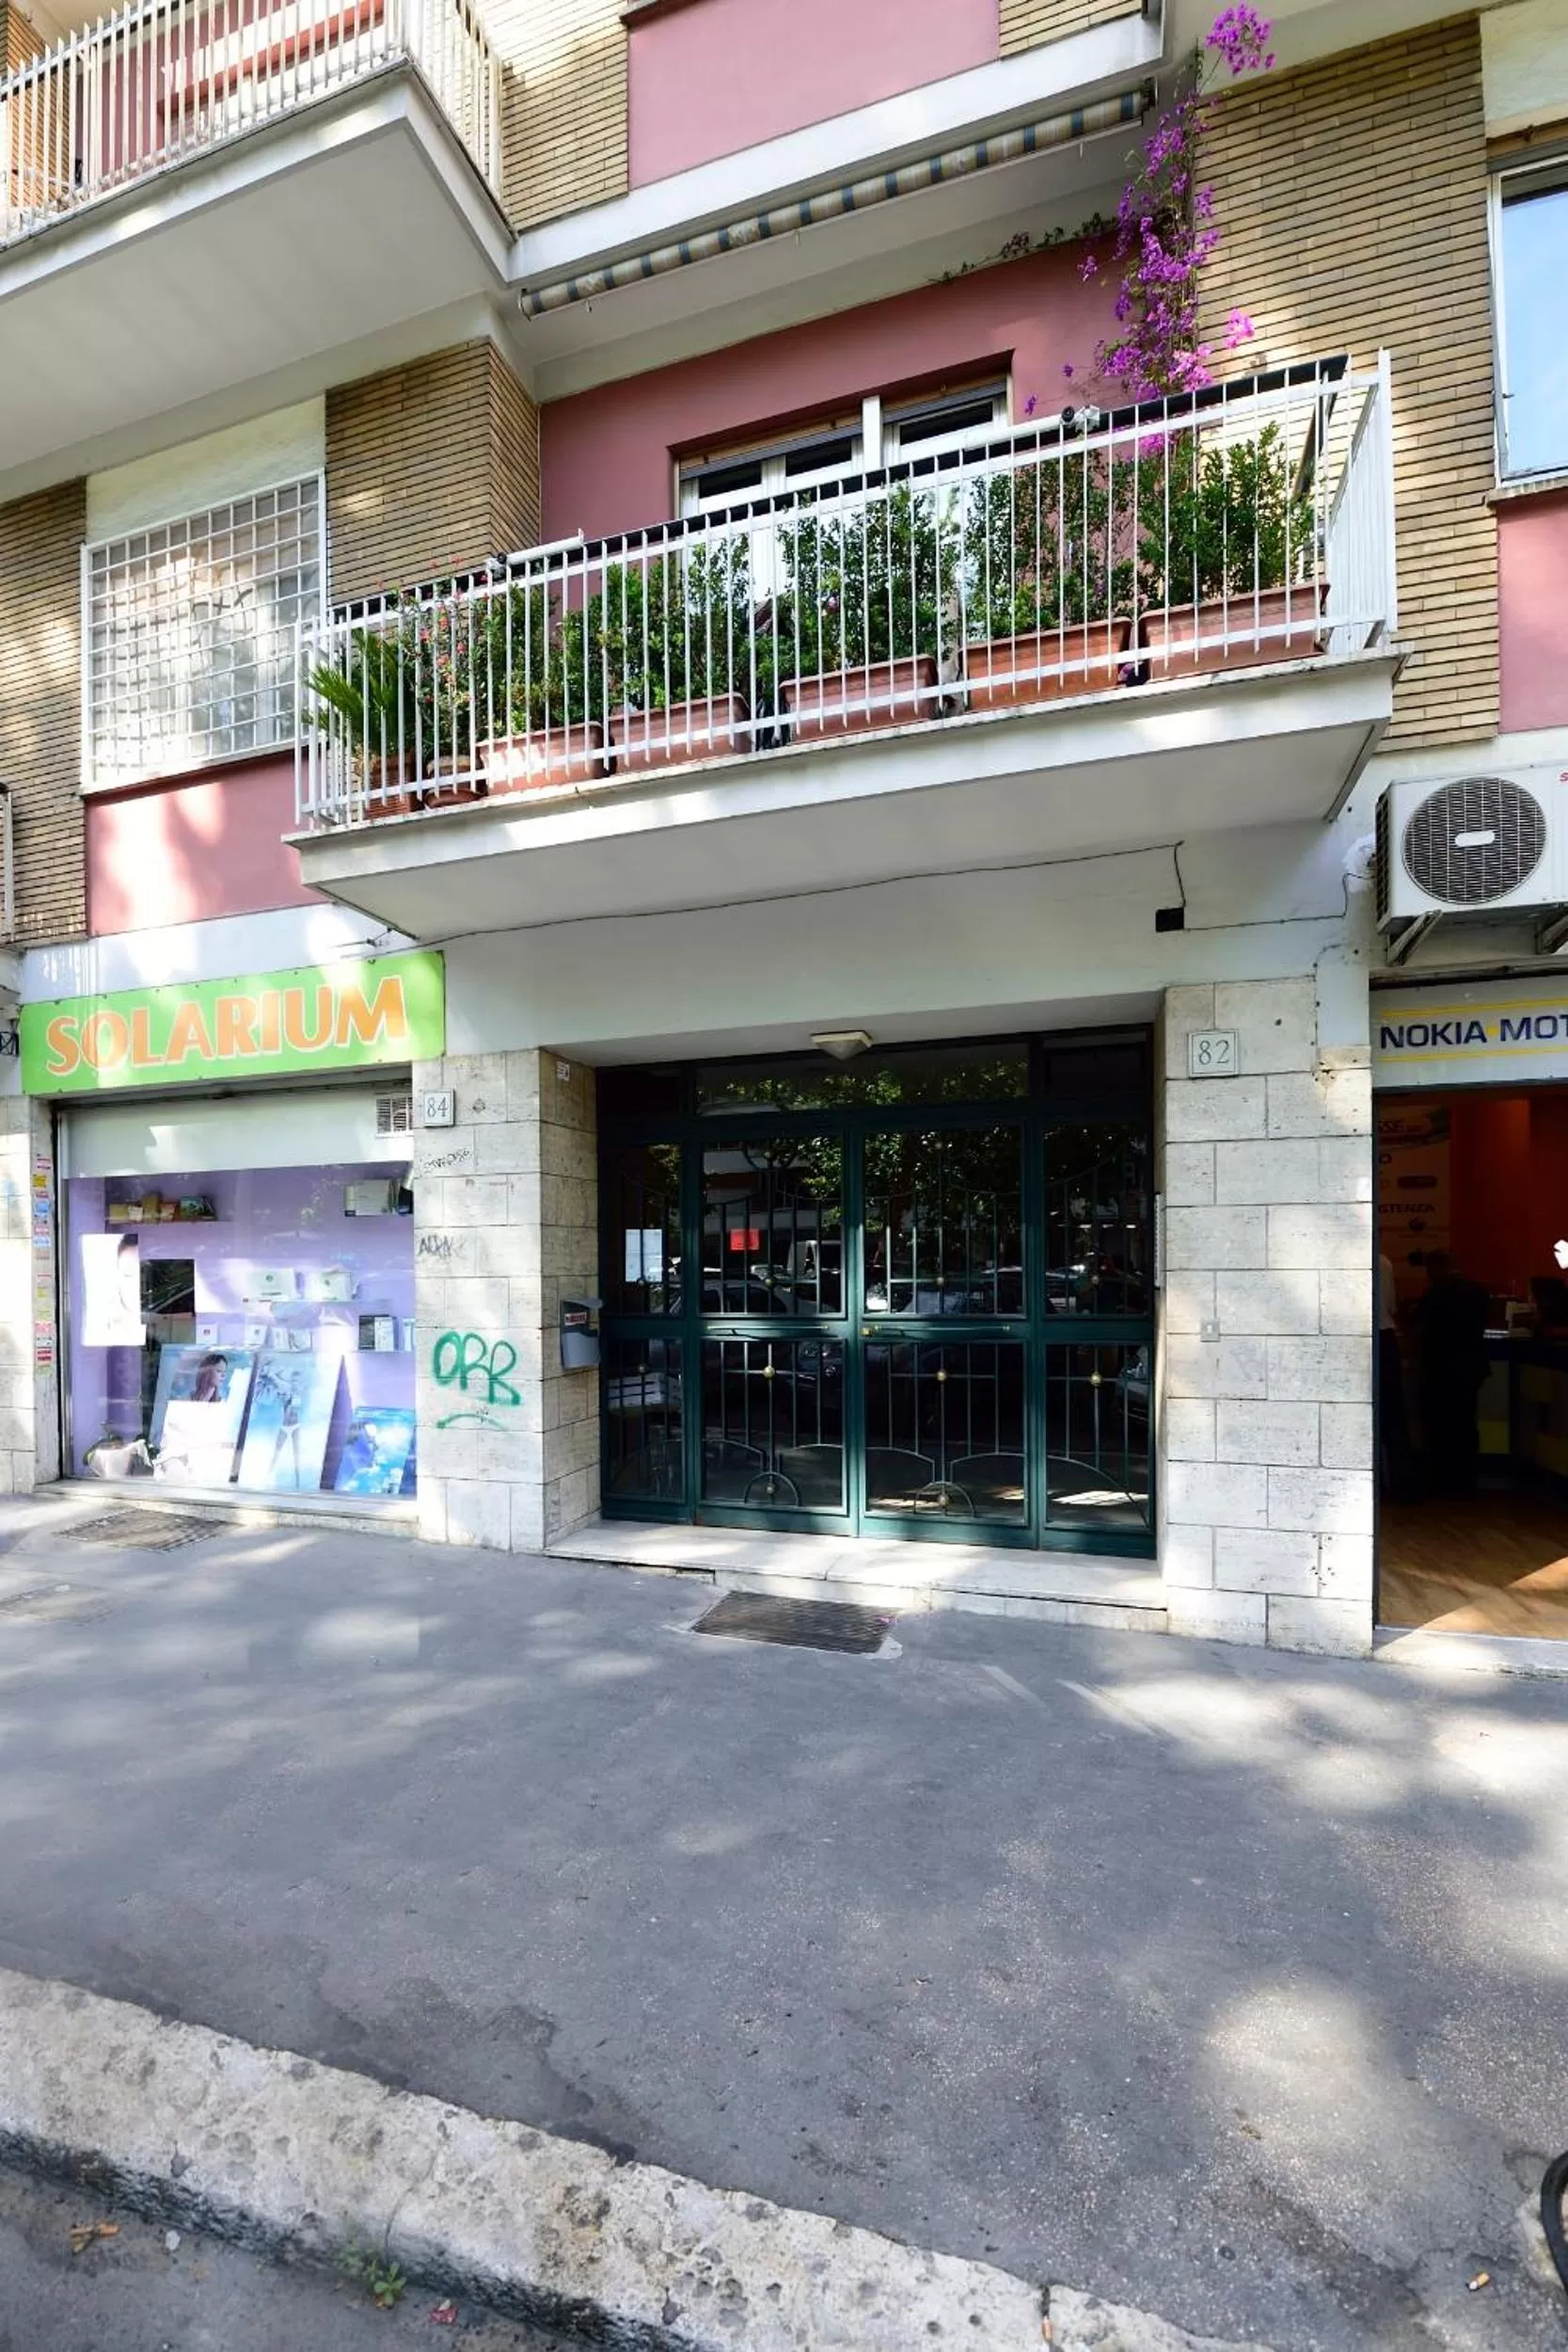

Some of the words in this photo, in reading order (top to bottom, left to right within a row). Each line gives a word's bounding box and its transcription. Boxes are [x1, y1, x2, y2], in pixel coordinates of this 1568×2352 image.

[47, 976, 408, 1075] SOLARIUM
[1381, 1021, 1487, 1049] NOKIA
[1199, 1040, 1229, 1065] 82
[427, 1097, 449, 1118] 84
